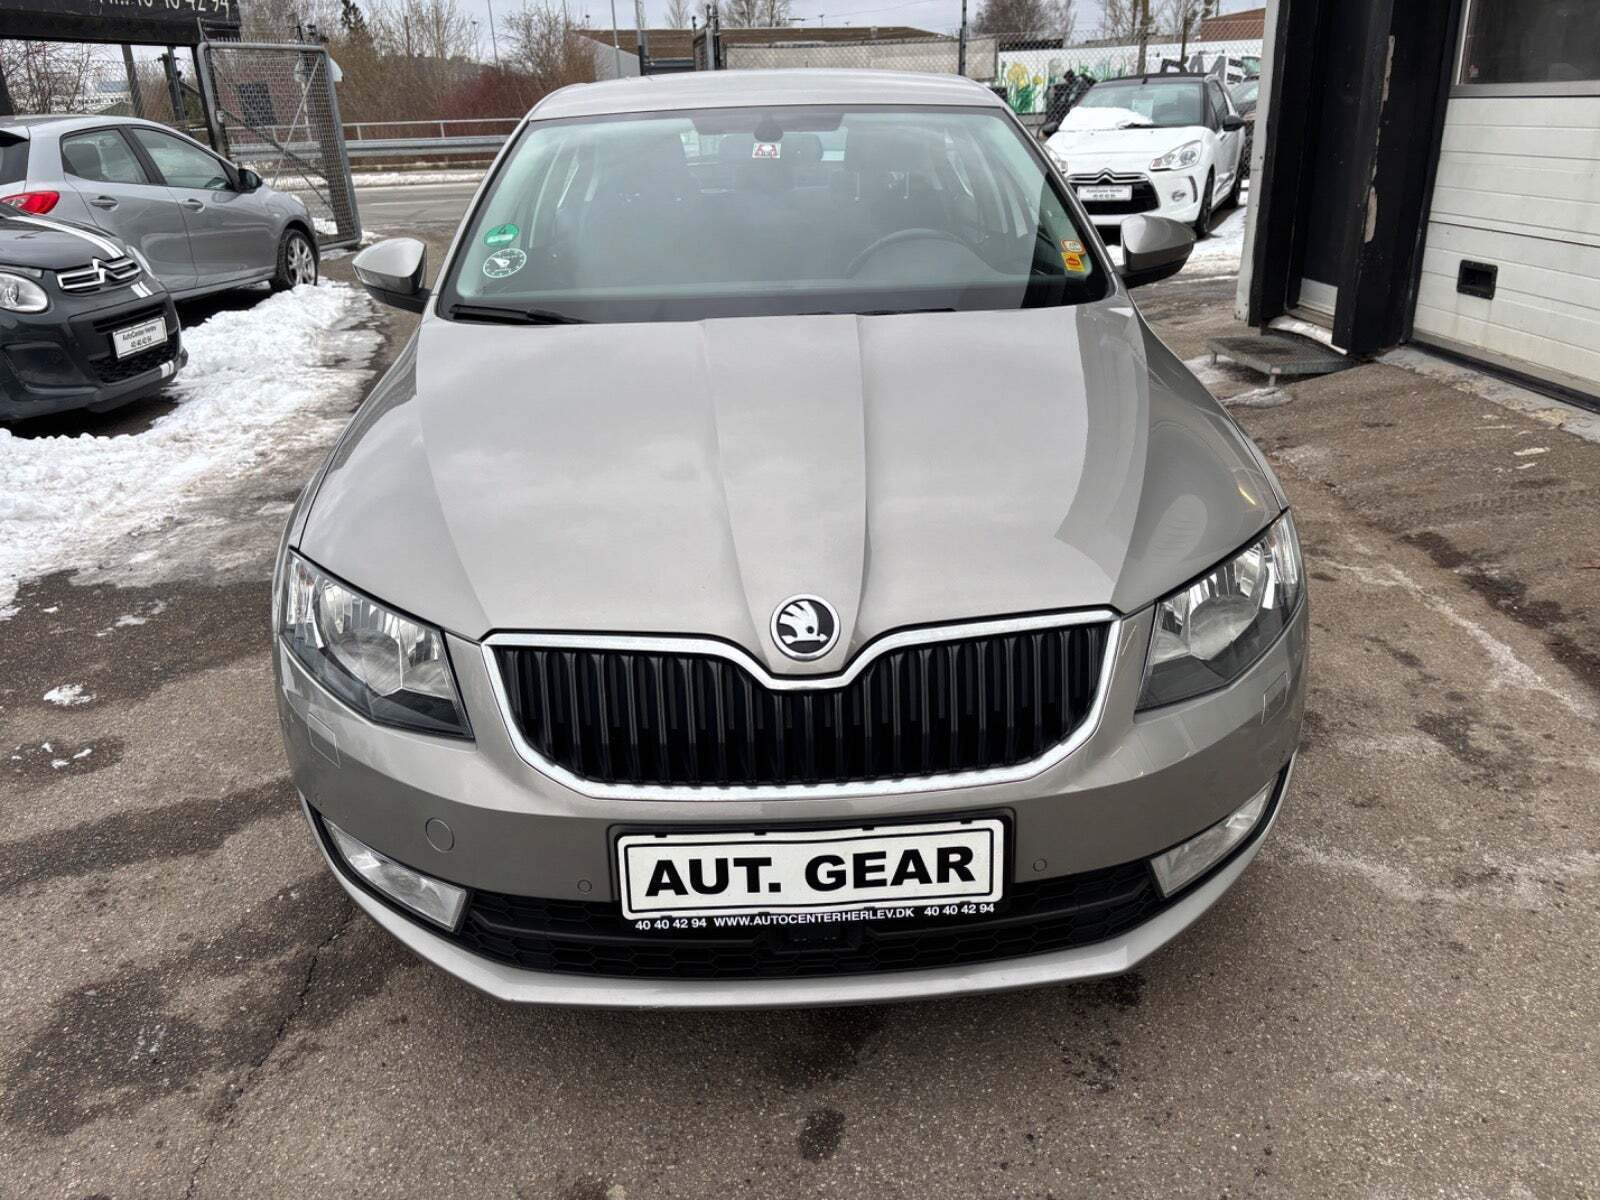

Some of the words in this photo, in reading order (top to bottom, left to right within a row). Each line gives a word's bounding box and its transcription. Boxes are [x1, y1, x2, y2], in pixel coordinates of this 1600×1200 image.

[645, 857, 782, 896] AUT.
[805, 846, 976, 892] GEAR
[635, 920, 651, 931] 40
[654, 919, 670, 929] 40
[672, 918, 689, 929] 42
[691, 917, 707, 928] 94
[714, 907, 915, 927] WWW.AUTOCENTERHERLEV.DK
[924, 906, 940, 916] 40
[942, 905, 958, 916] 40
[961, 903, 977, 915] 42
[979, 902, 995, 914] 94
